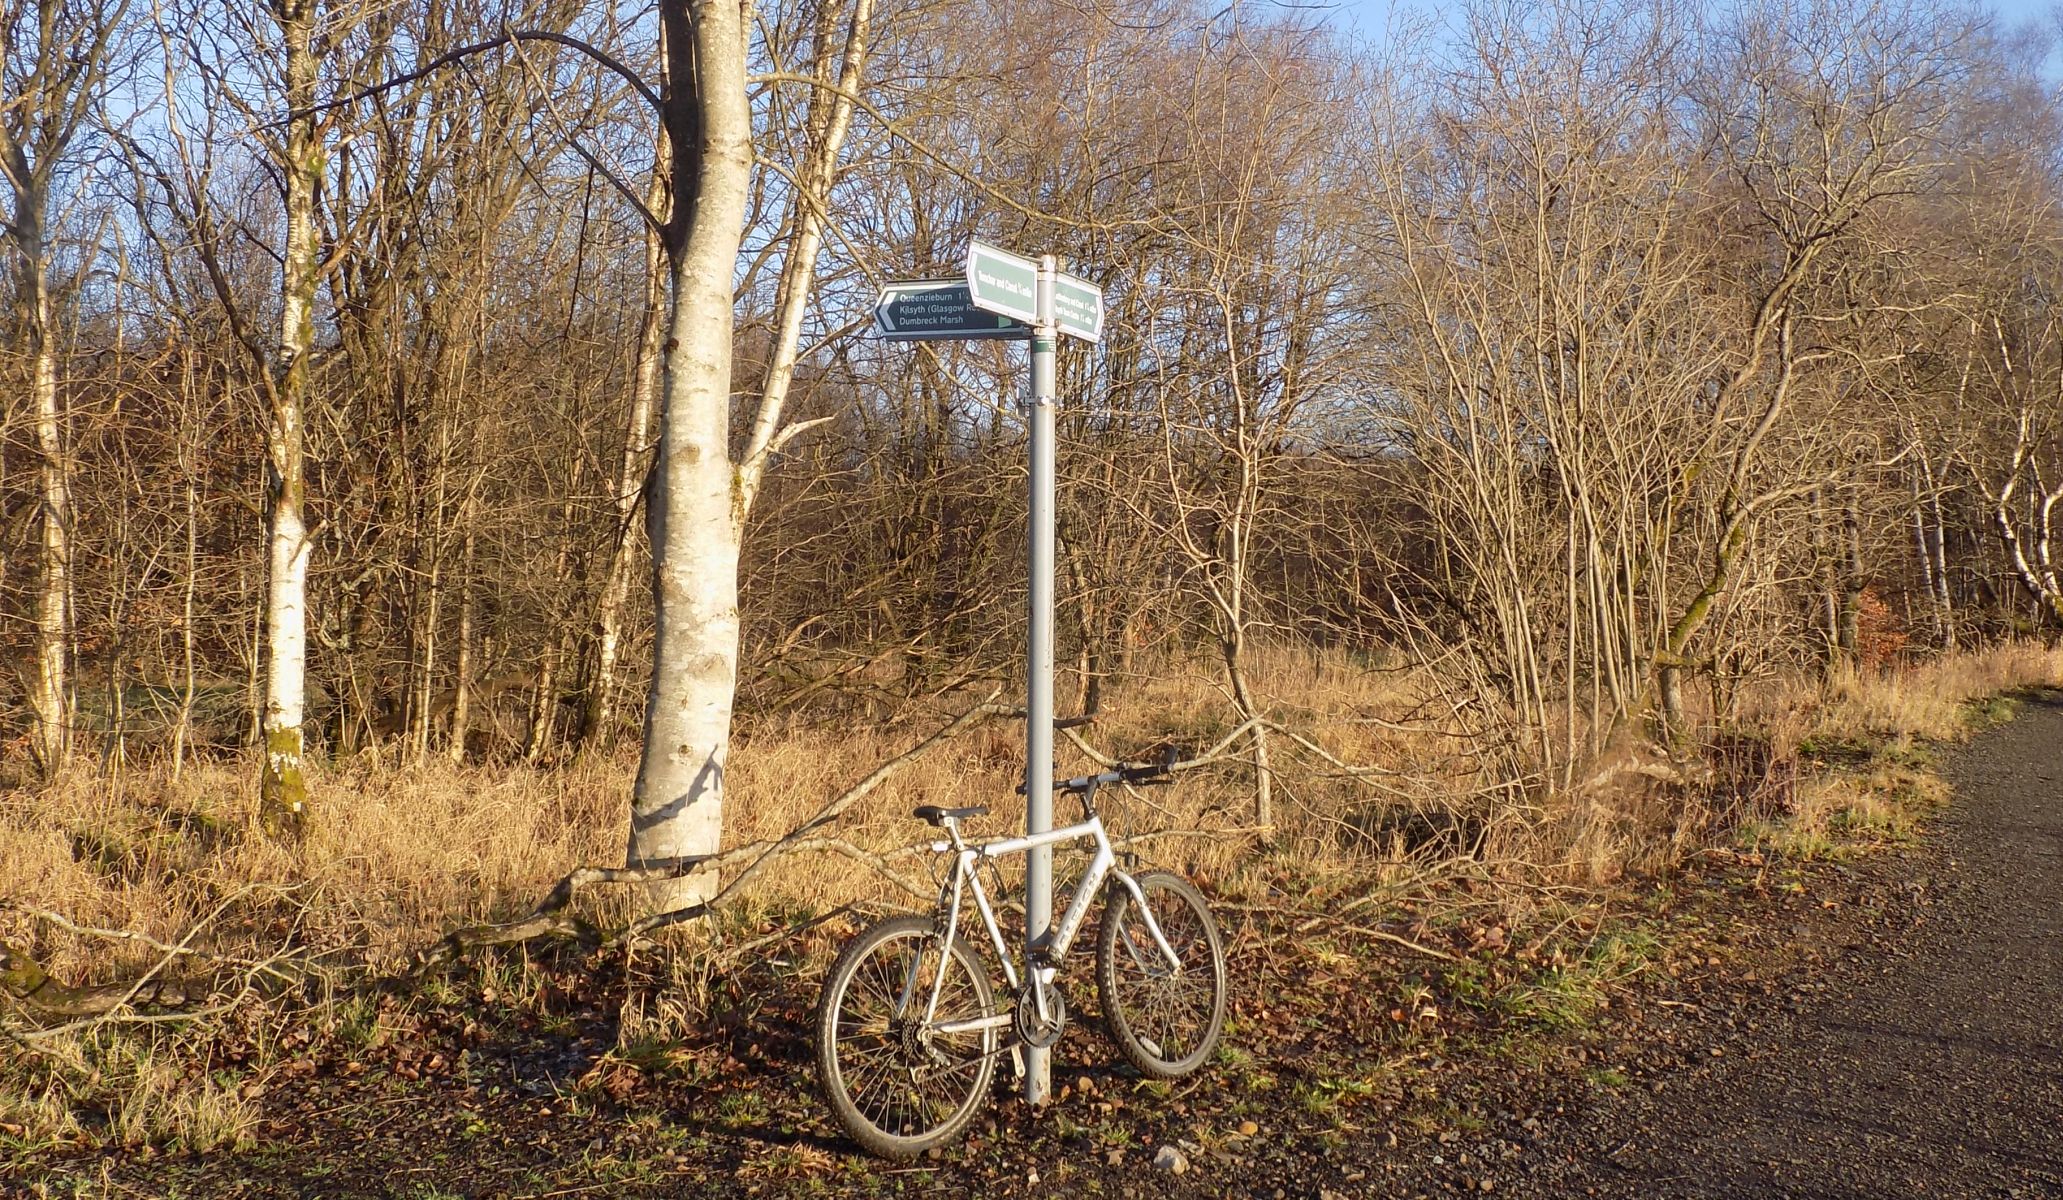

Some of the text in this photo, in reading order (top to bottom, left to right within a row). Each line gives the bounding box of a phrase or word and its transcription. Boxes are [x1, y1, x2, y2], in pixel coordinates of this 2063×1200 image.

[899, 292, 952, 302] Queenzieburn
[899, 305, 925, 315] Kilsyth
[927, 303, 964, 314] (Glasgow
[899, 315, 963, 325] Dumbreck Marsh
[1056, 871, 1099, 950] ALEIGH
